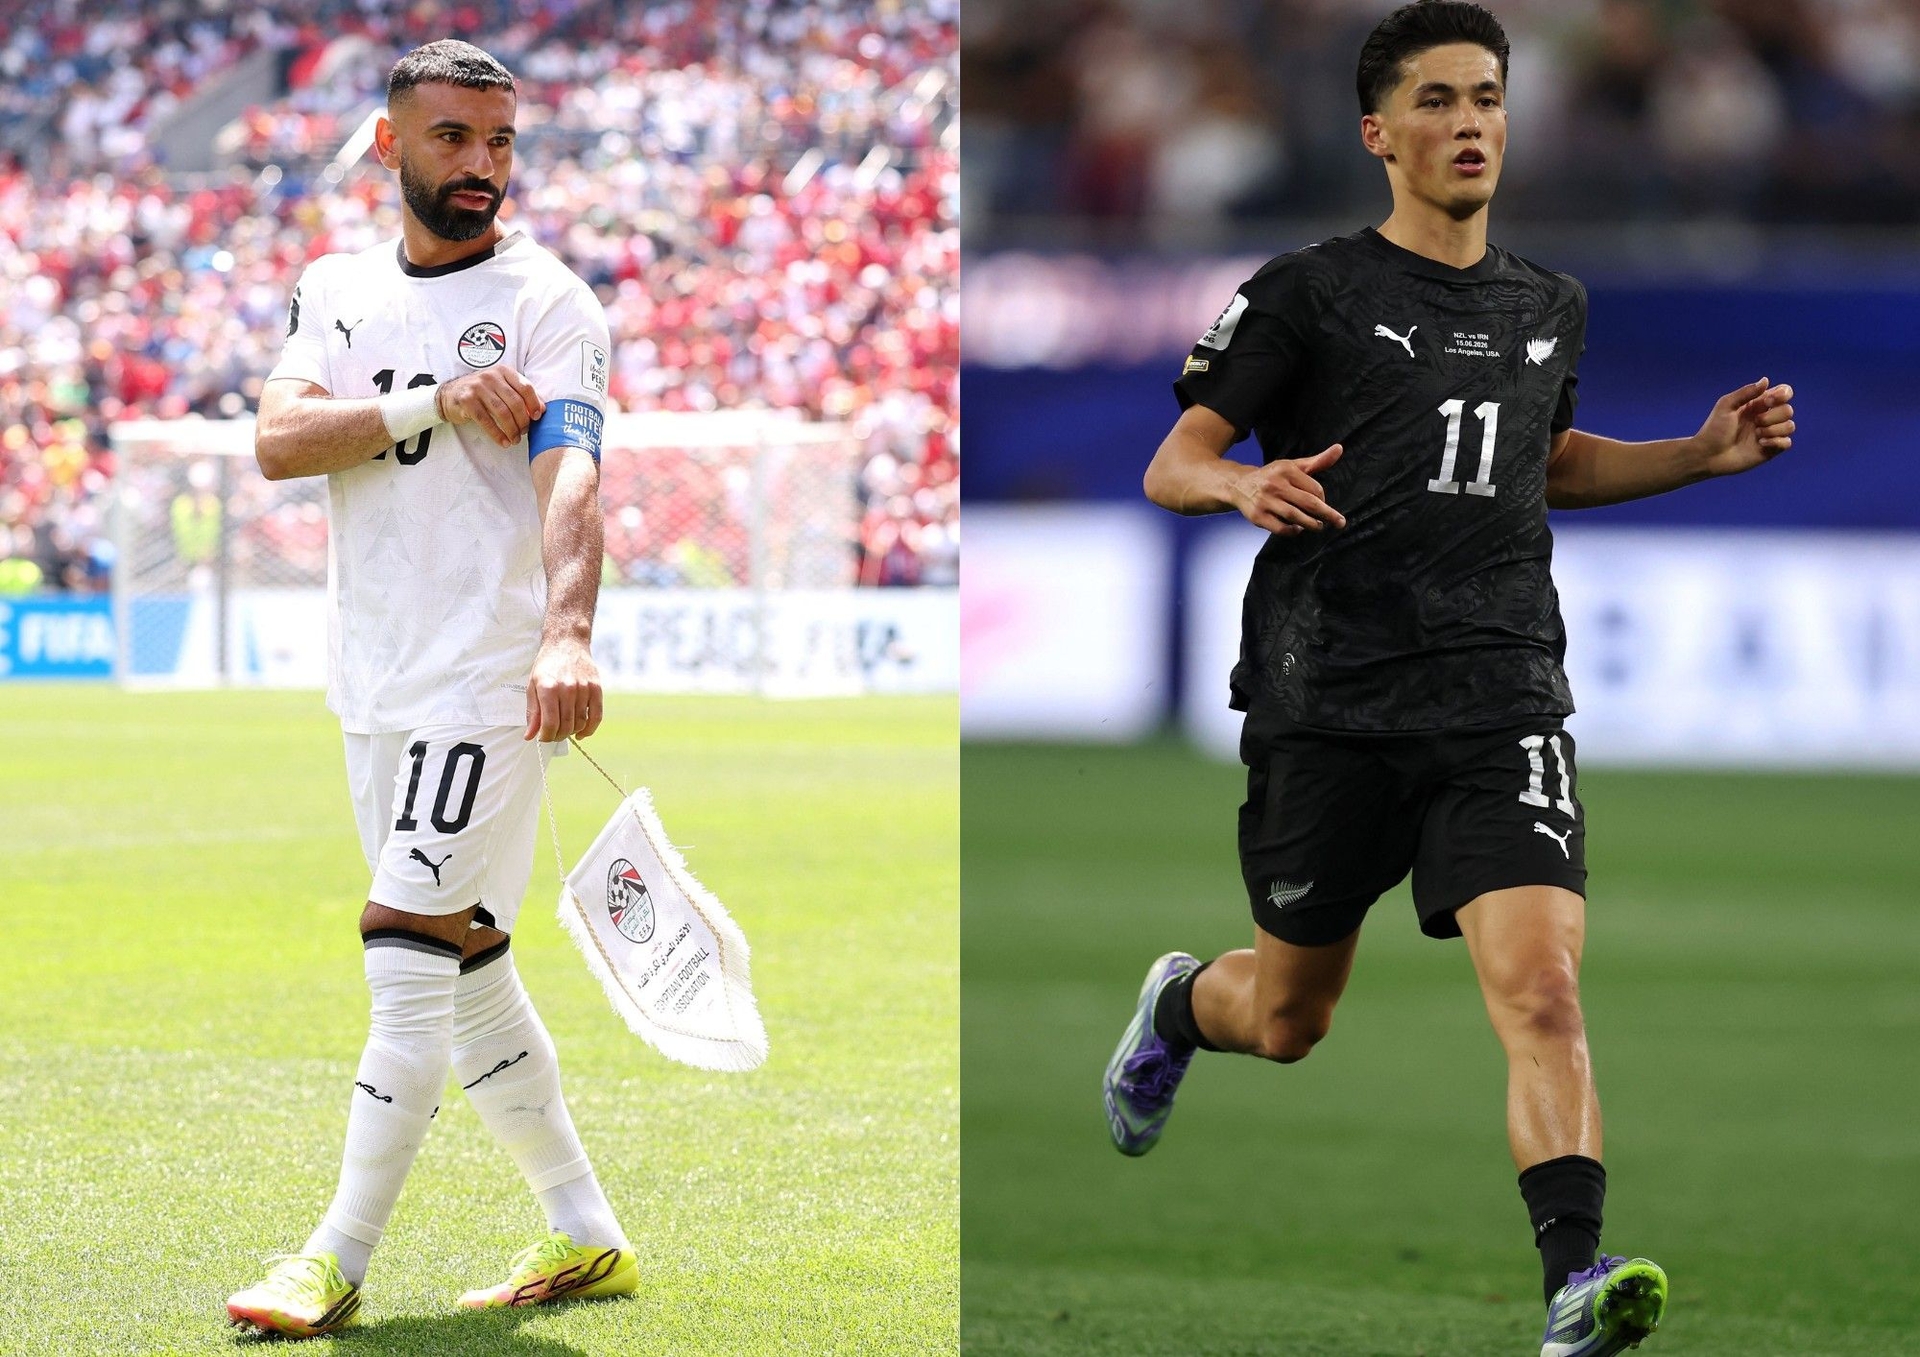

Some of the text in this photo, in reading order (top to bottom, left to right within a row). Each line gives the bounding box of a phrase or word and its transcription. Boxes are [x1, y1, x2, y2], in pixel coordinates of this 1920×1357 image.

[1444, 346, 1457, 354] Los
[1457, 348, 1485, 357] Angeles,
[1427, 398, 1501, 498] 11
[395, 741, 487, 834] 10
[1518, 735, 1576, 820] 11
[673, 970, 711, 1015] ASSOCIATION
[677, 947, 709, 984] FOOTBALL
